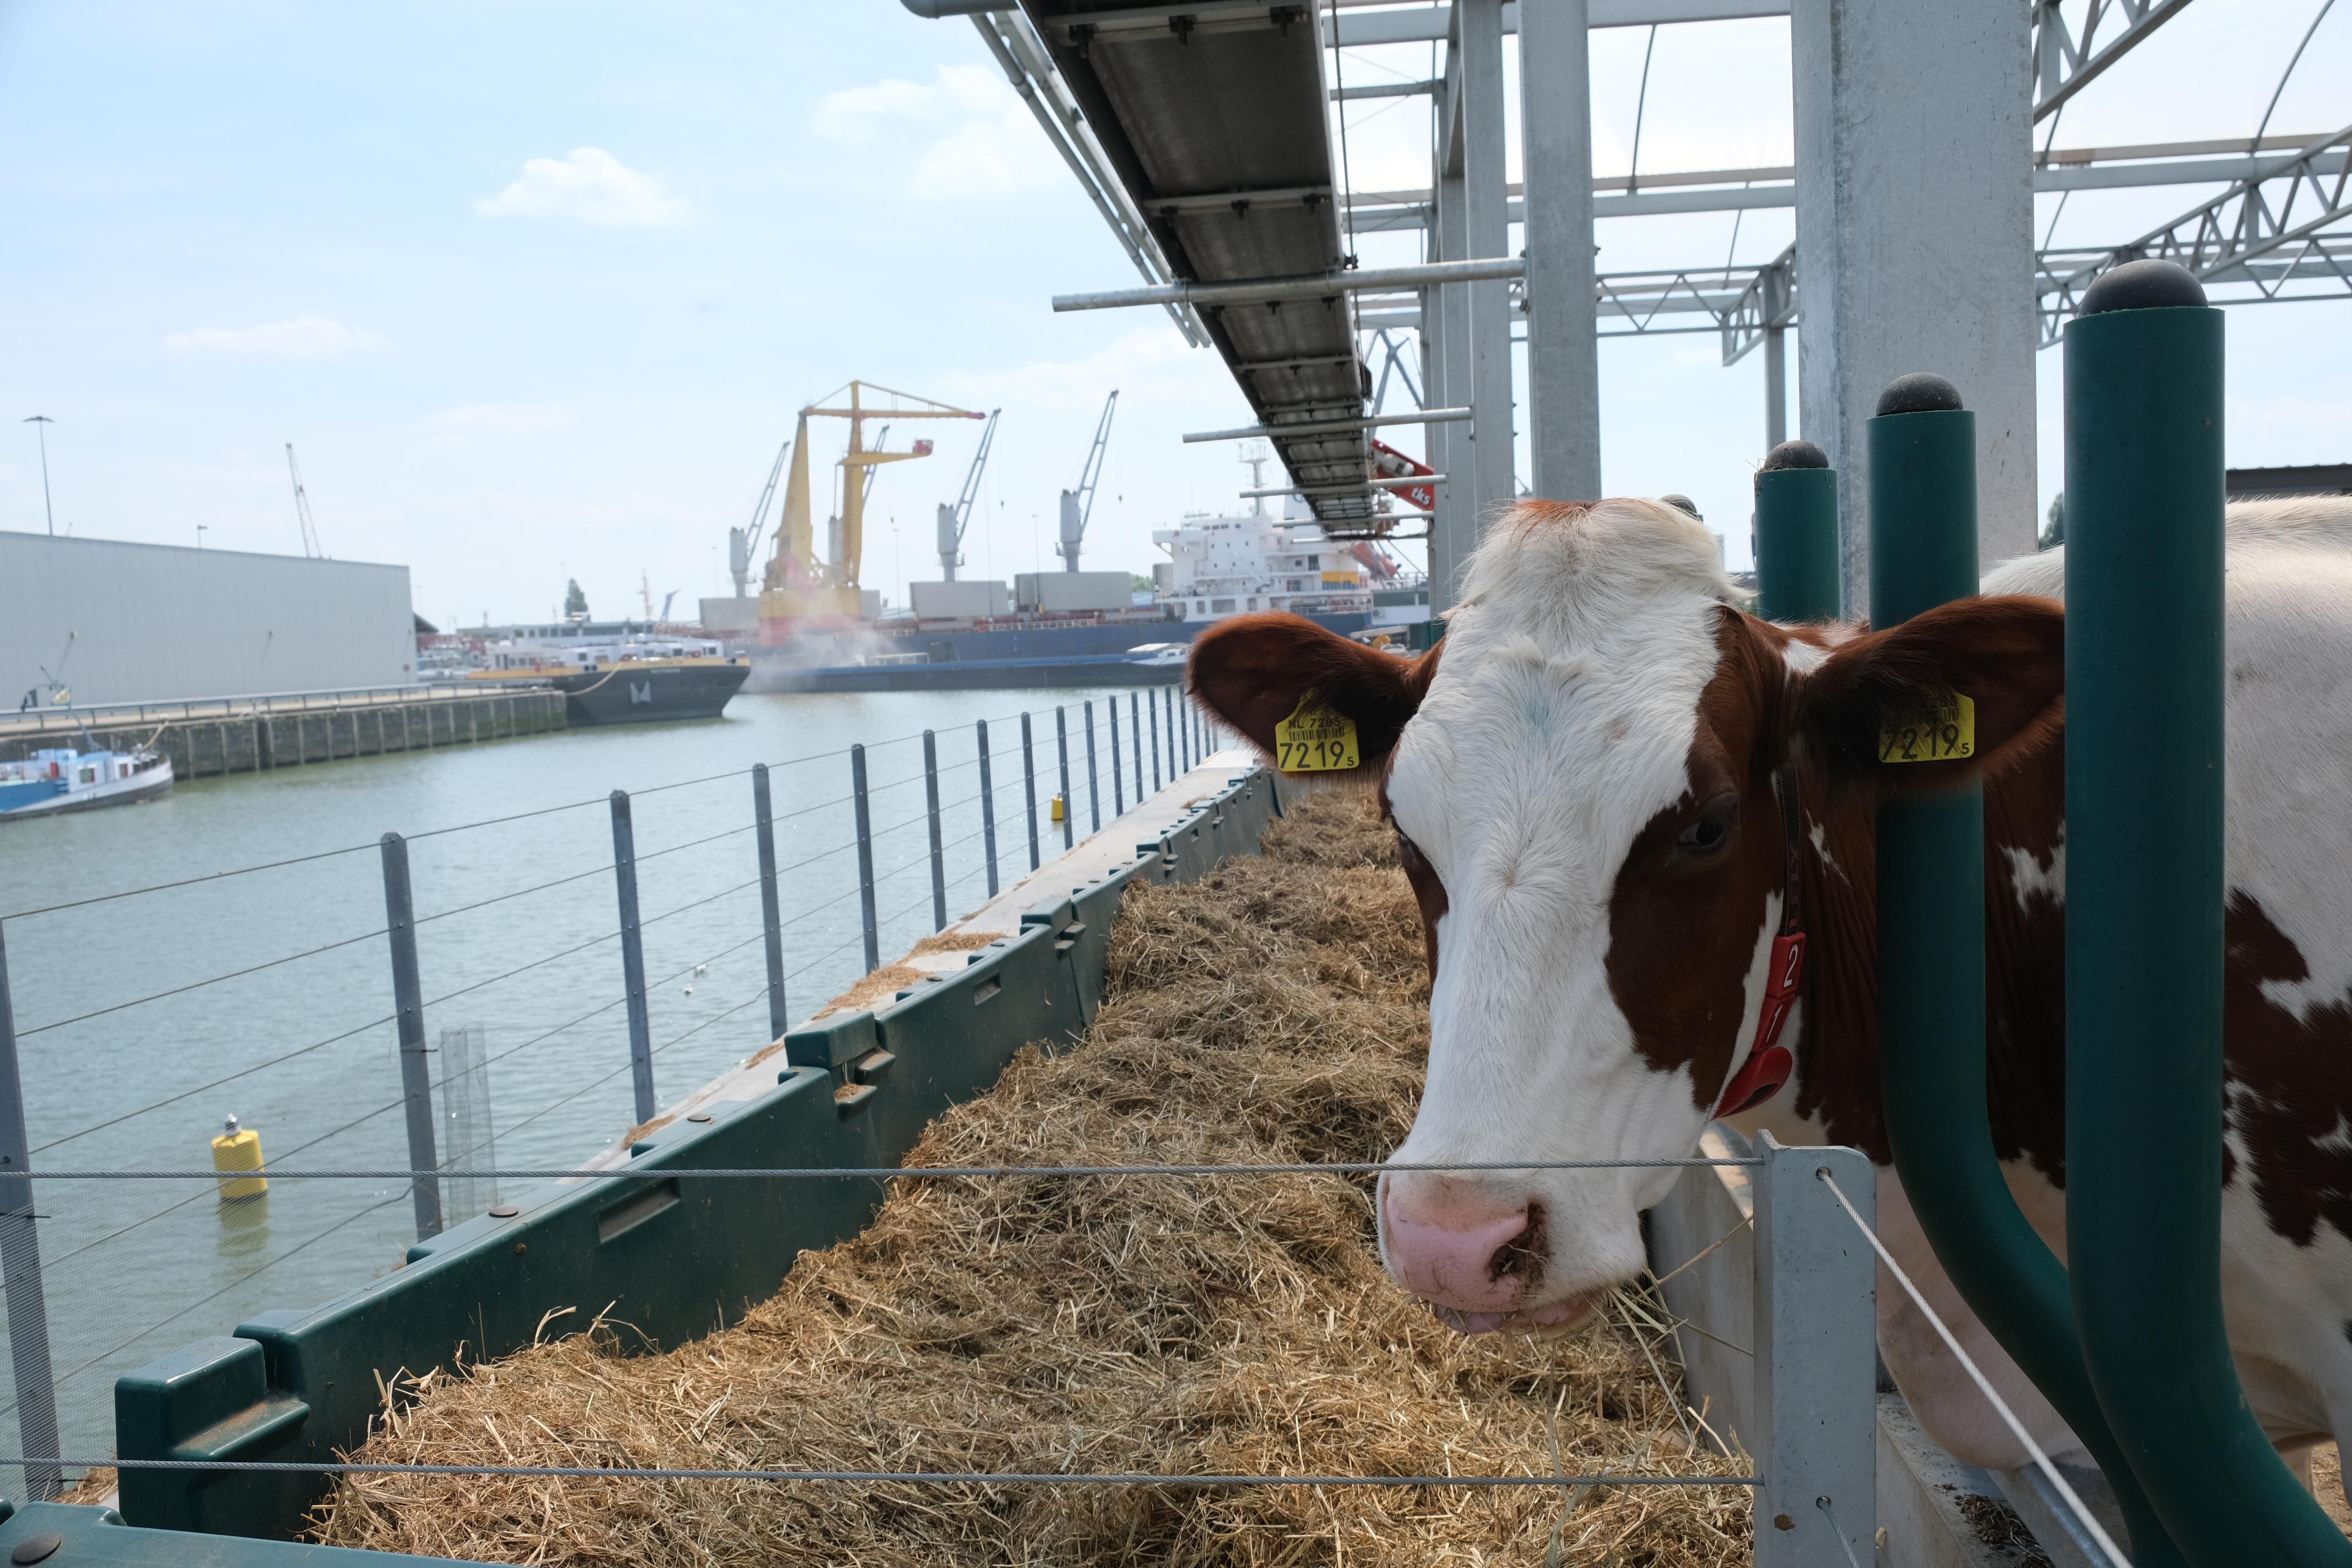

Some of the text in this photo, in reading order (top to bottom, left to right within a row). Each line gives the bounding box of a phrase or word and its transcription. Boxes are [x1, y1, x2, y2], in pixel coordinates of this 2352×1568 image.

[1411, 487, 1431, 505] tks
[1289, 719, 1304, 729] NL
[1882, 724, 1959, 761] 7219
[1279, 740, 1345, 769] 7219
